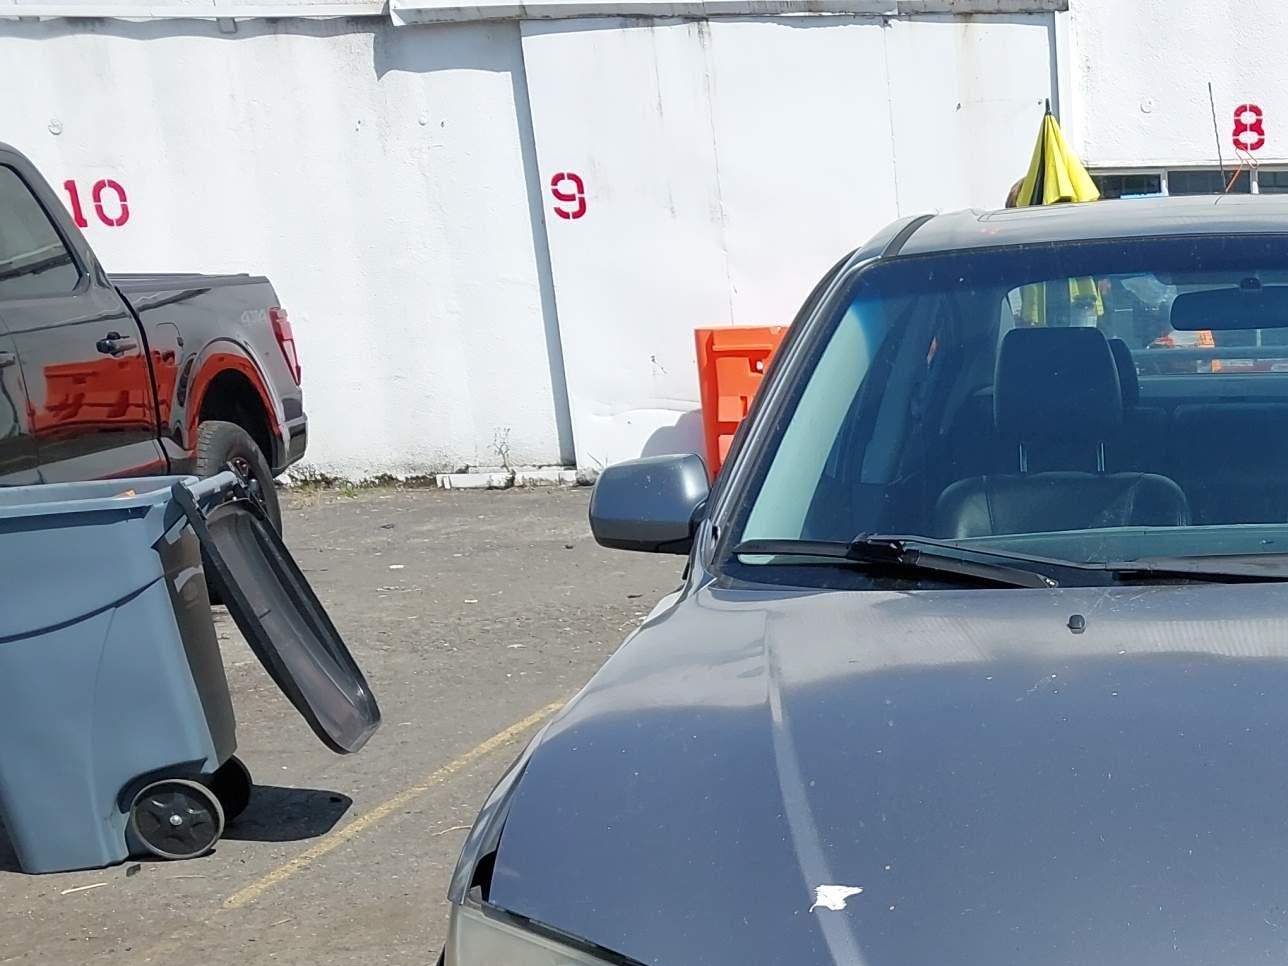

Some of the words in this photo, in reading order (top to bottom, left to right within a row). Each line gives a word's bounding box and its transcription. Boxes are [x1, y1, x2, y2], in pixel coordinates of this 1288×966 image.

[1231, 104, 1265, 150] 8
[63, 179, 130, 229] 10
[551, 172, 587, 220] 9
